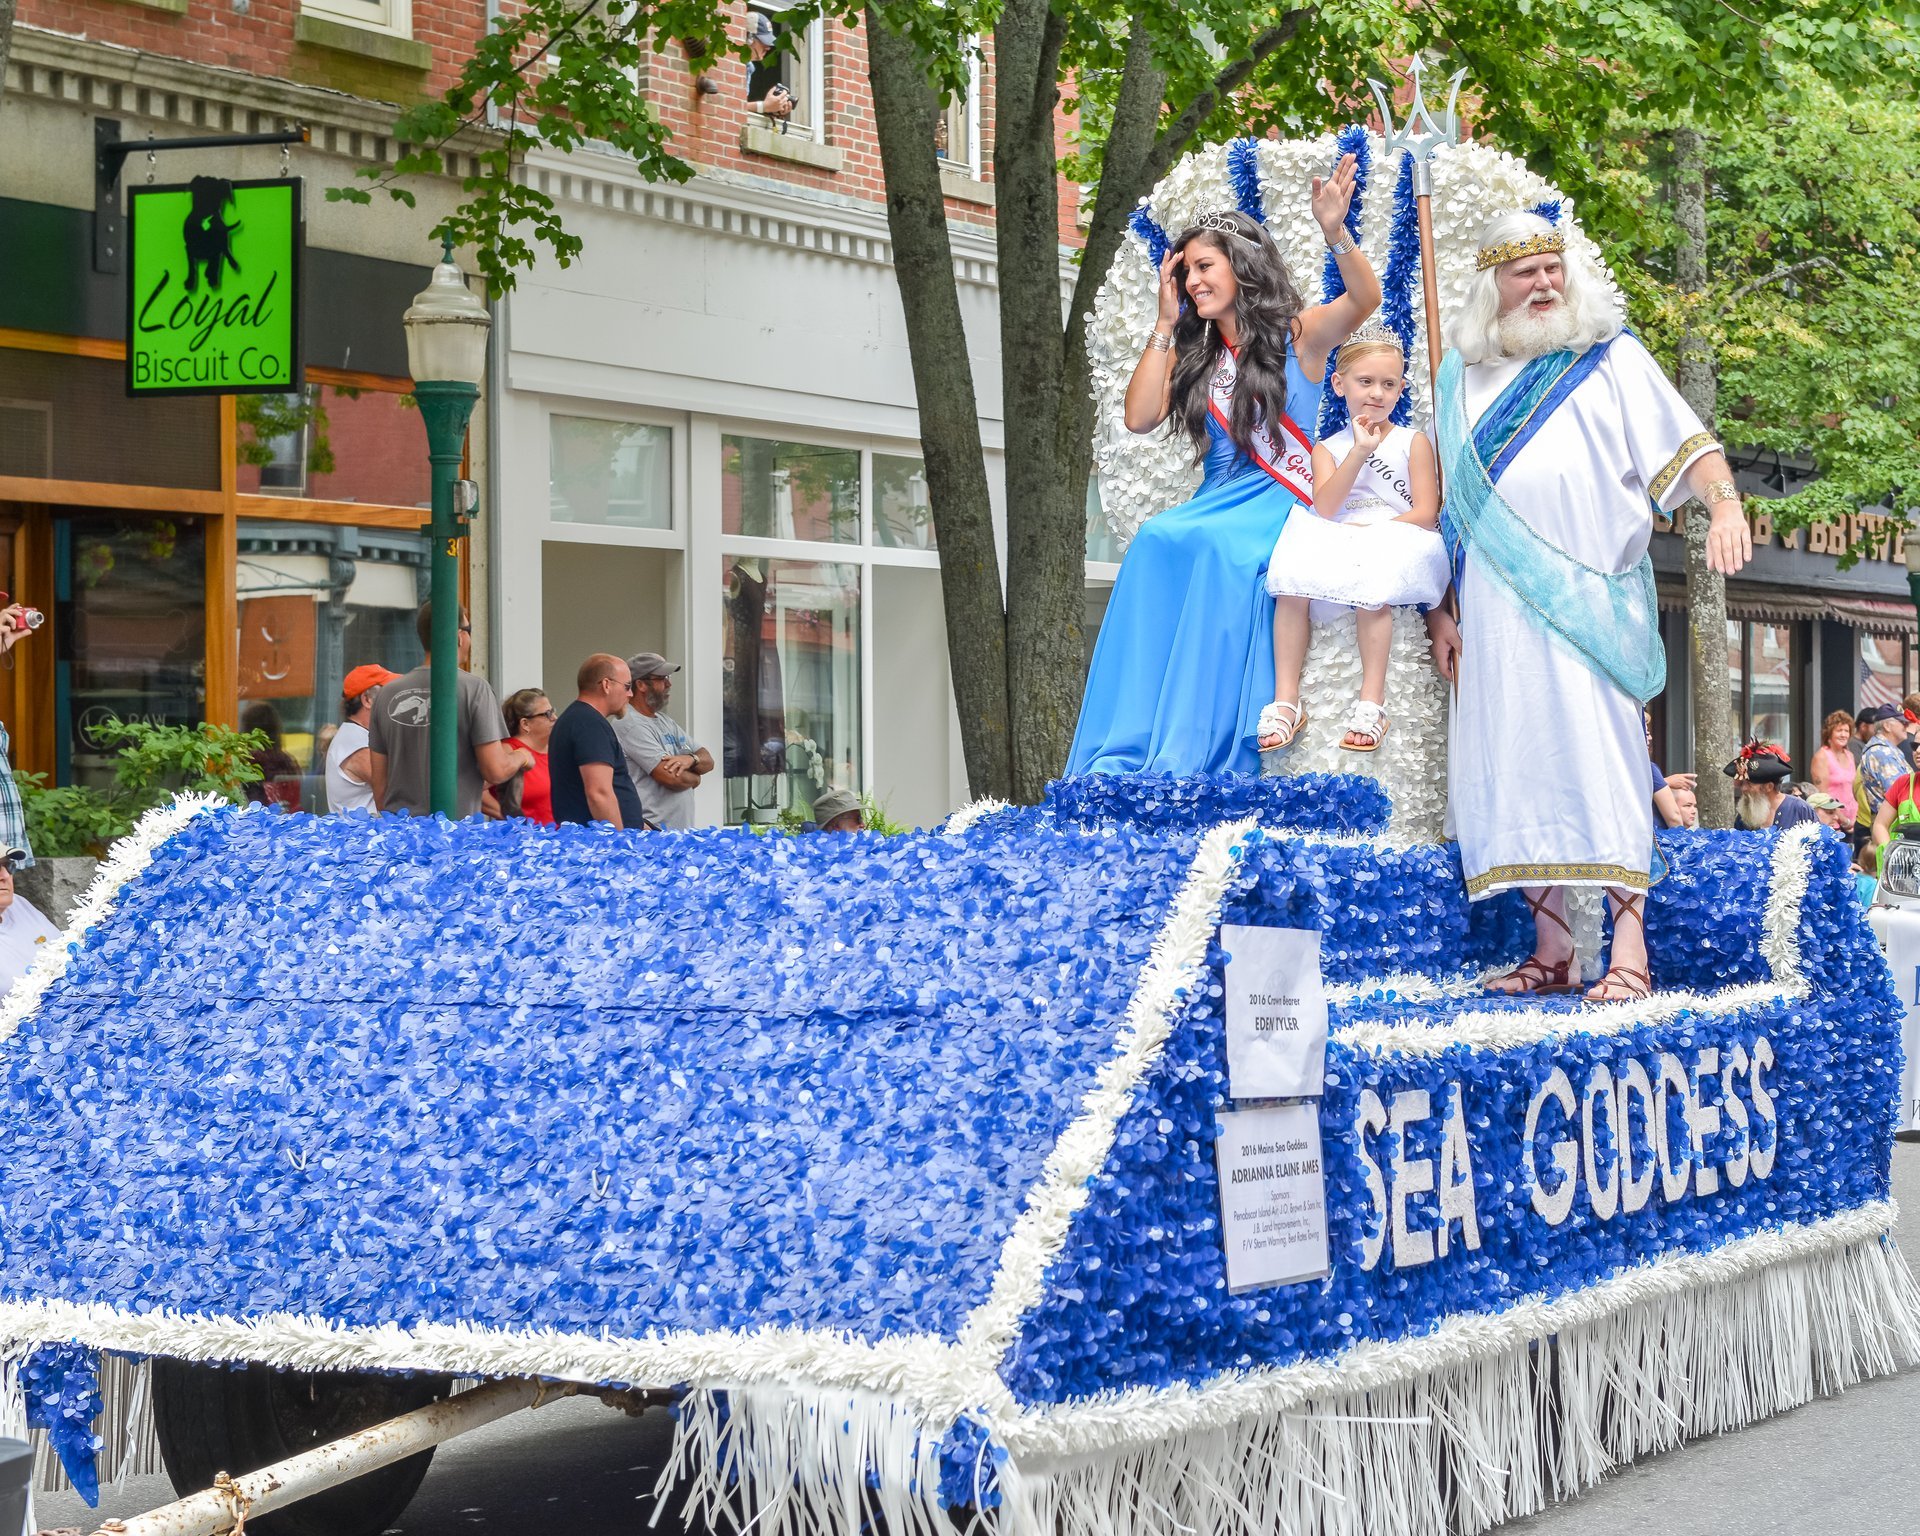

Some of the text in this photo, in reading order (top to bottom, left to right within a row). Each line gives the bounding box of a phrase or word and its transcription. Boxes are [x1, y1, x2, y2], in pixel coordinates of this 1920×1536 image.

[138, 269, 277, 352] Loyal
[136, 347, 287, 383] Biscuit Co.
[1249, 994, 1300, 1006] 2016 Crown Bearer
[1255, 1016, 1300, 1031] EDEN TYLER
[1241, 1139, 1308, 1157] 2016 Maine Sea Goddess
[1354, 1036, 1778, 1272] SEA GODDESS
[1231, 1159, 1319, 1184] ADRIANNA ELAINE AMES
[1242, 1238, 1253, 1252] F/V
